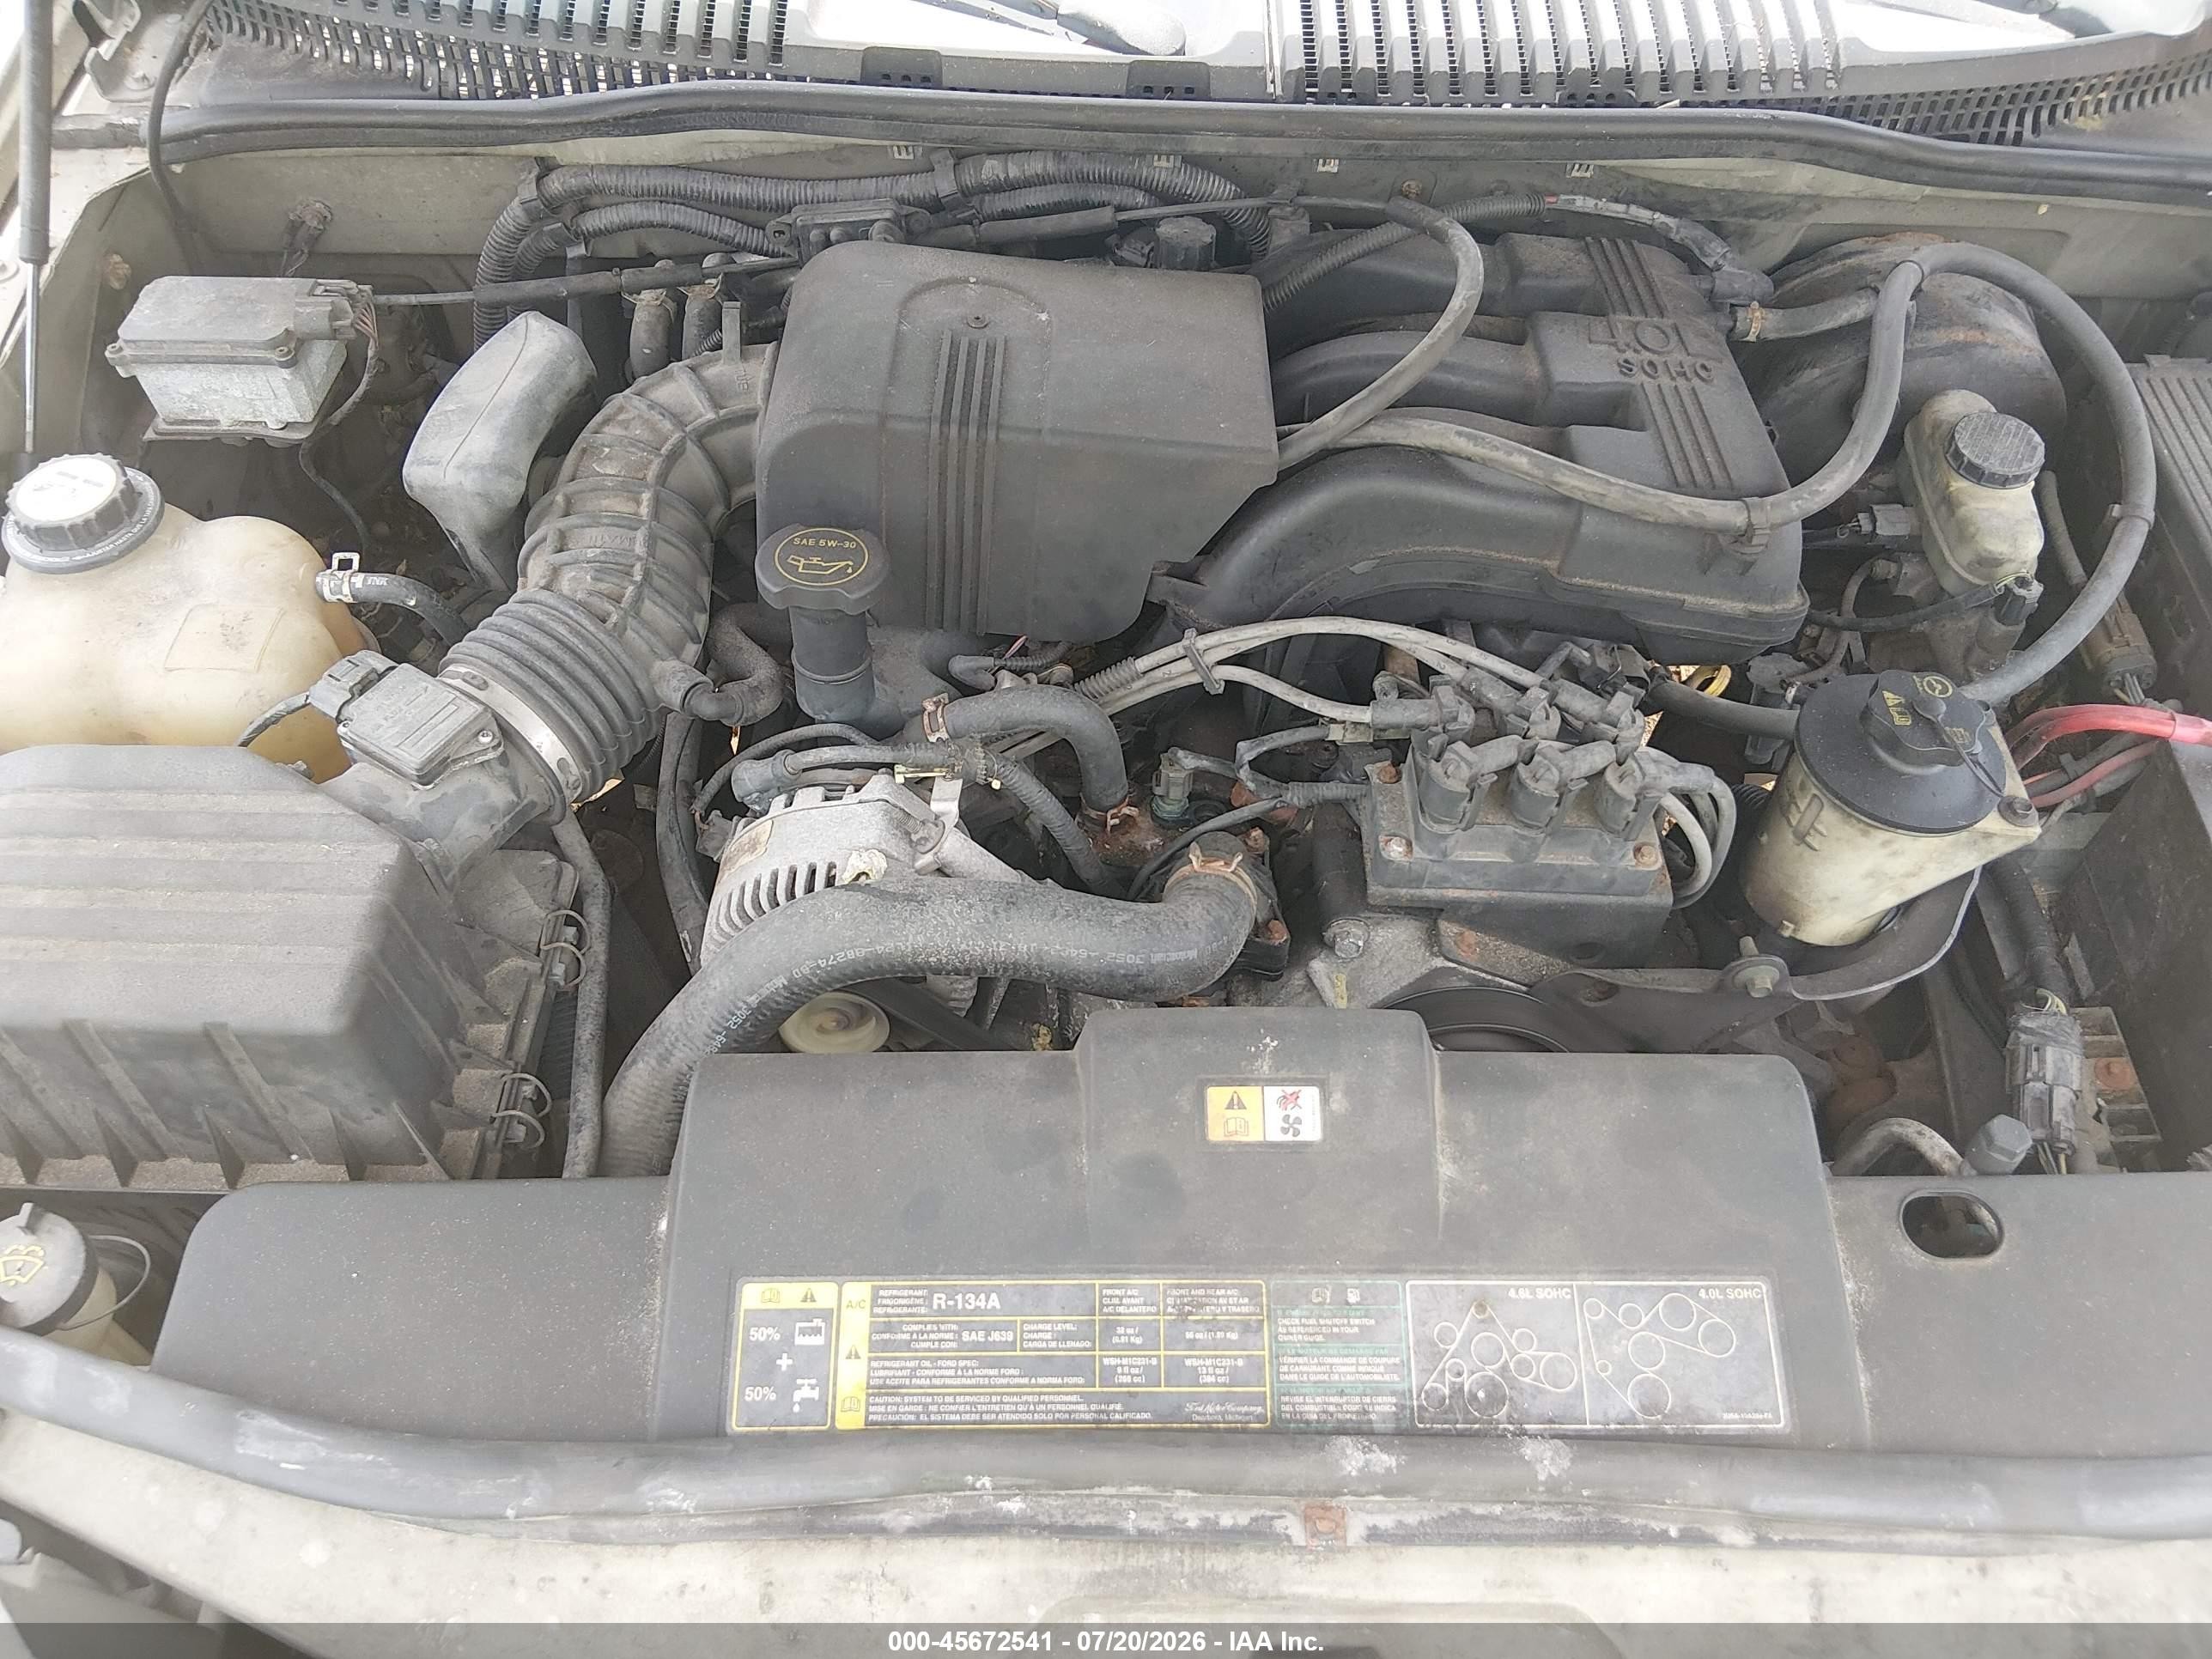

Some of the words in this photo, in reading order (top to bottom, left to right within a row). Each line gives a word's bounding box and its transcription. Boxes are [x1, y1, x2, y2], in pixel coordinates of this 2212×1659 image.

[1617, 357, 1715, 381] SOHC
[819, 538, 857, 549] 5W-30
[727, 1005, 753, 1030] 3052
[1536, 1289, 1571, 1299] SOHC
[1698, 1289, 1723, 1299] 4.0L
[1726, 1289, 1761, 1299] SOHC
[846, 1300, 866, 1310] A/C
[933, 1293, 1001, 1310] R-134A
[749, 1327, 781, 1341] 50%
[962, 1331, 985, 1341] SAE
[988, 1331, 1013, 1342] J639
[744, 1386, 777, 1401] 50%
